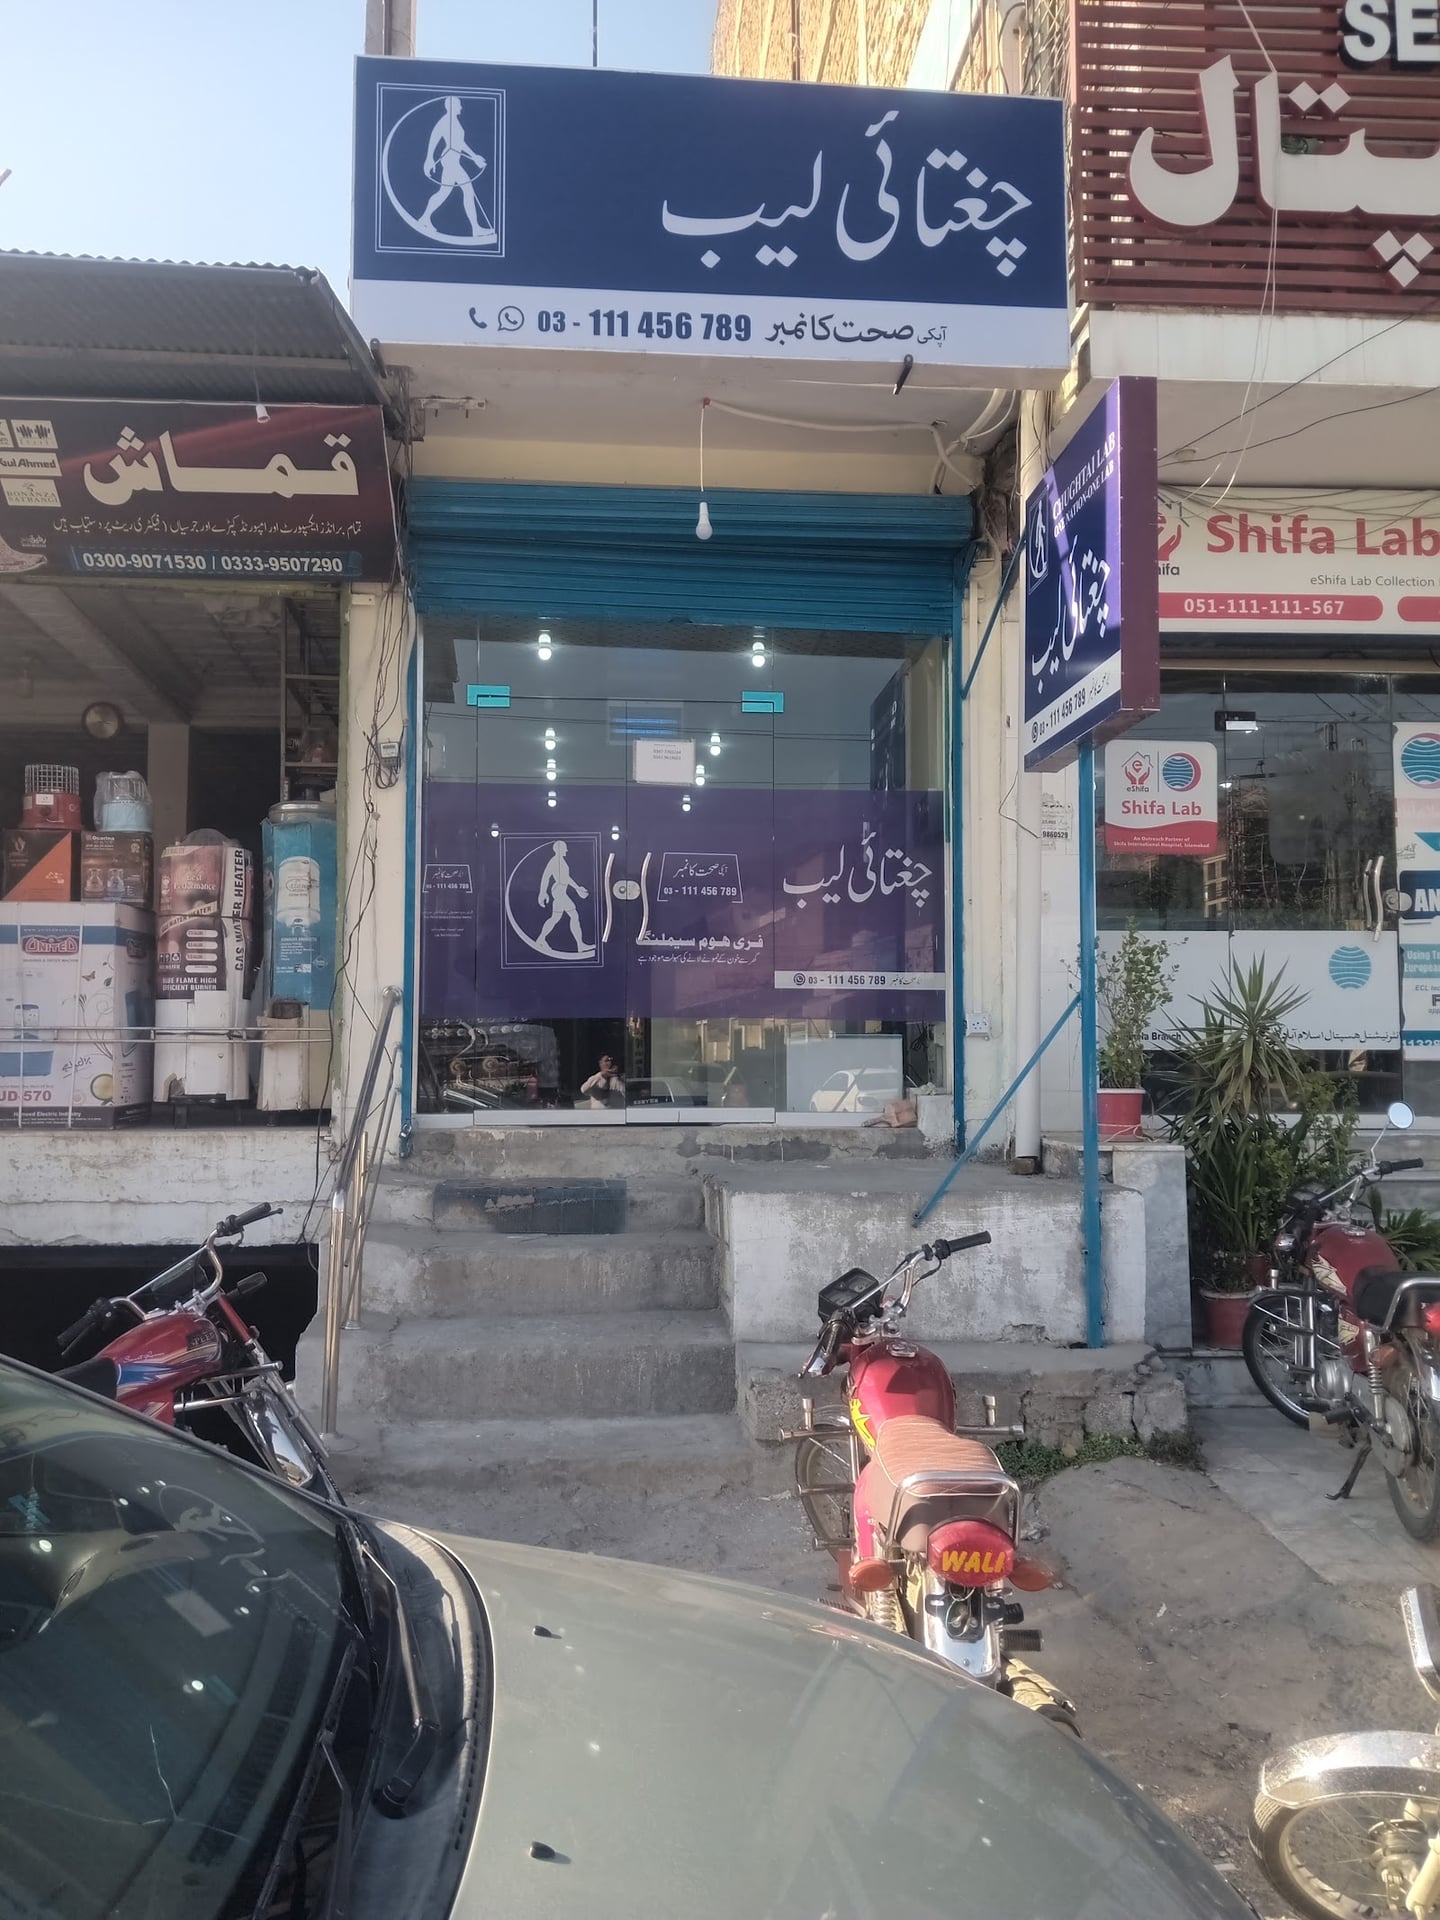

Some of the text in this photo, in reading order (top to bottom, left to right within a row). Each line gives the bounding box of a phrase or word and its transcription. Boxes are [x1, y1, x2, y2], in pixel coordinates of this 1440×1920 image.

[661, 110, 1032, 277] چغتائی لیب
[537, 310, 566, 333] 03
[589, 309, 629, 337] 111
[637, 311, 693, 340] 456
[700, 313, 752, 342] 789
[764, 312, 807, 346] نمبر
[811, 314, 835, 341] کا
[833, 319, 915, 342] صحت
[18, 458, 56, 470] Ahmed
[83, 425, 360, 506] قماش
[1053, 431, 1116, 520] CHUGHTAI LAB
[1054, 516, 1066, 538] ONE
[1100, 459, 1115, 484] LAB
[1206, 513, 1440, 557] Shifa Lab
[82, 552, 207, 570] 0300-9071530
[221, 555, 343, 573] 0333-9507290
[1310, 574, 1435, 587] eShifa Lab Collection
[1032, 535, 1111, 694] چغتائی لیب
[1183, 598, 1345, 615] 051-111-111-567
[1074, 687, 1086, 711] 789
[1126, 785, 1150, 793] eShifa
[1121, 800, 1202, 816] Shifa Lab
[783, 831, 933, 909] چغتائی لیب
[663, 887, 673, 895] 03
[682, 886, 698, 896] 111
[700, 886, 718, 896] 456
[720, 886, 737, 897] 789
[232, 849, 245, 972] GAS WATER HEATER
[25, 936, 79, 954] UNITED
[1407, 950, 1431, 961] Using
[808, 976, 818, 984] 03
[828, 974, 844, 985] 111
[847, 975, 865, 985] 456
[868, 975, 886, 985] 789
[941, 1549, 1006, 1574] WALI
